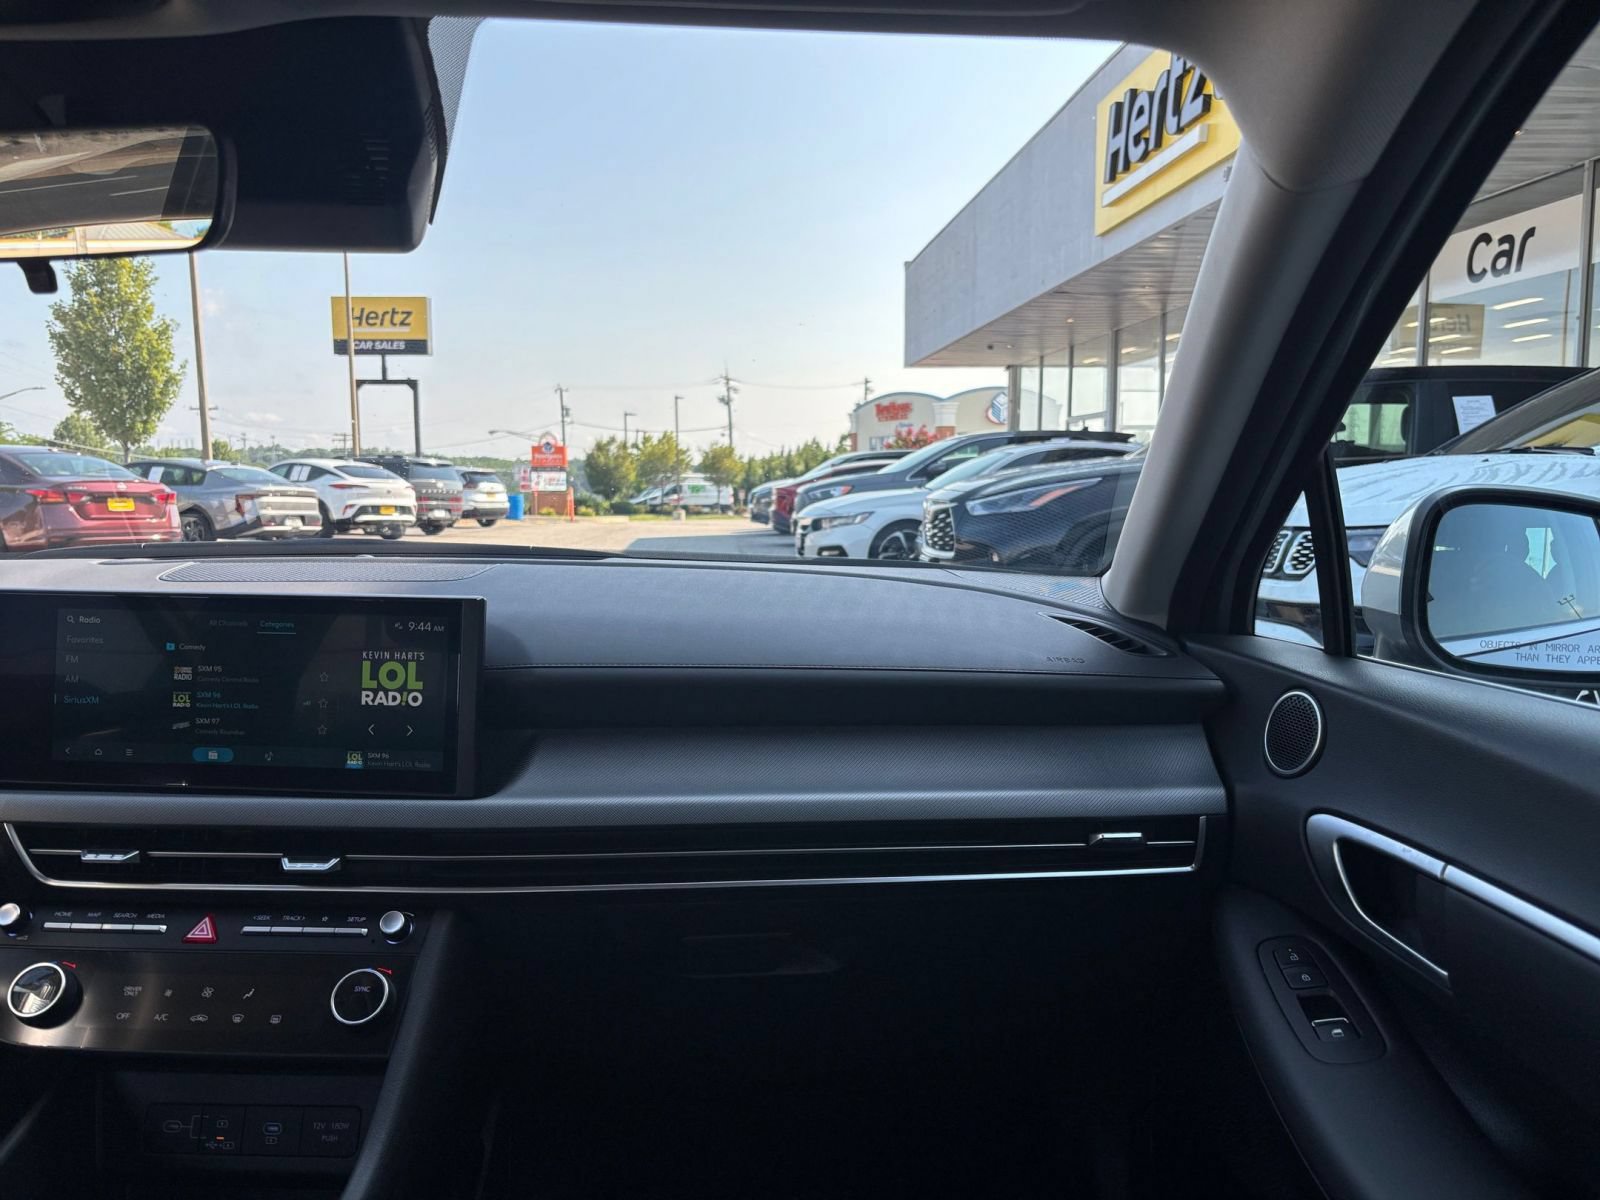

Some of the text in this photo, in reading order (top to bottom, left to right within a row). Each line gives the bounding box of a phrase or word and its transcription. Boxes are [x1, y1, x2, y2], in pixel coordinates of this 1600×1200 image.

[1103, 51, 1212, 184] Hertz
[1467, 226, 1536, 283] Car
[352, 307, 413, 326] Hertz
[374, 340, 406, 350] SALES
[79, 615, 101, 624] Radio
[408, 621, 432, 632] 9:44
[66, 634, 104, 645] Favorites
[179, 643, 206, 652] Comedy
[1480, 639, 1521, 649] OBJECTS
[1546, 643, 1580, 653] MIRROR
[65, 655, 79, 663] FM
[363, 651, 390, 660] KEVIN
[1515, 652, 1540, 662] THAN
[1546, 654, 1572, 664] THEY
[197, 665, 212, 673] SXM
[65, 674, 79, 683] AM
[362, 660, 424, 690] LOL
[64, 695, 99, 705] SiriusXM
[172, 694, 191, 703] LOL
[195, 717, 210, 725] SXM
[354, 985, 372, 993] SYNC
[116, 1012, 131, 1020] OFF
[154, 1013, 169, 1021] A/C
